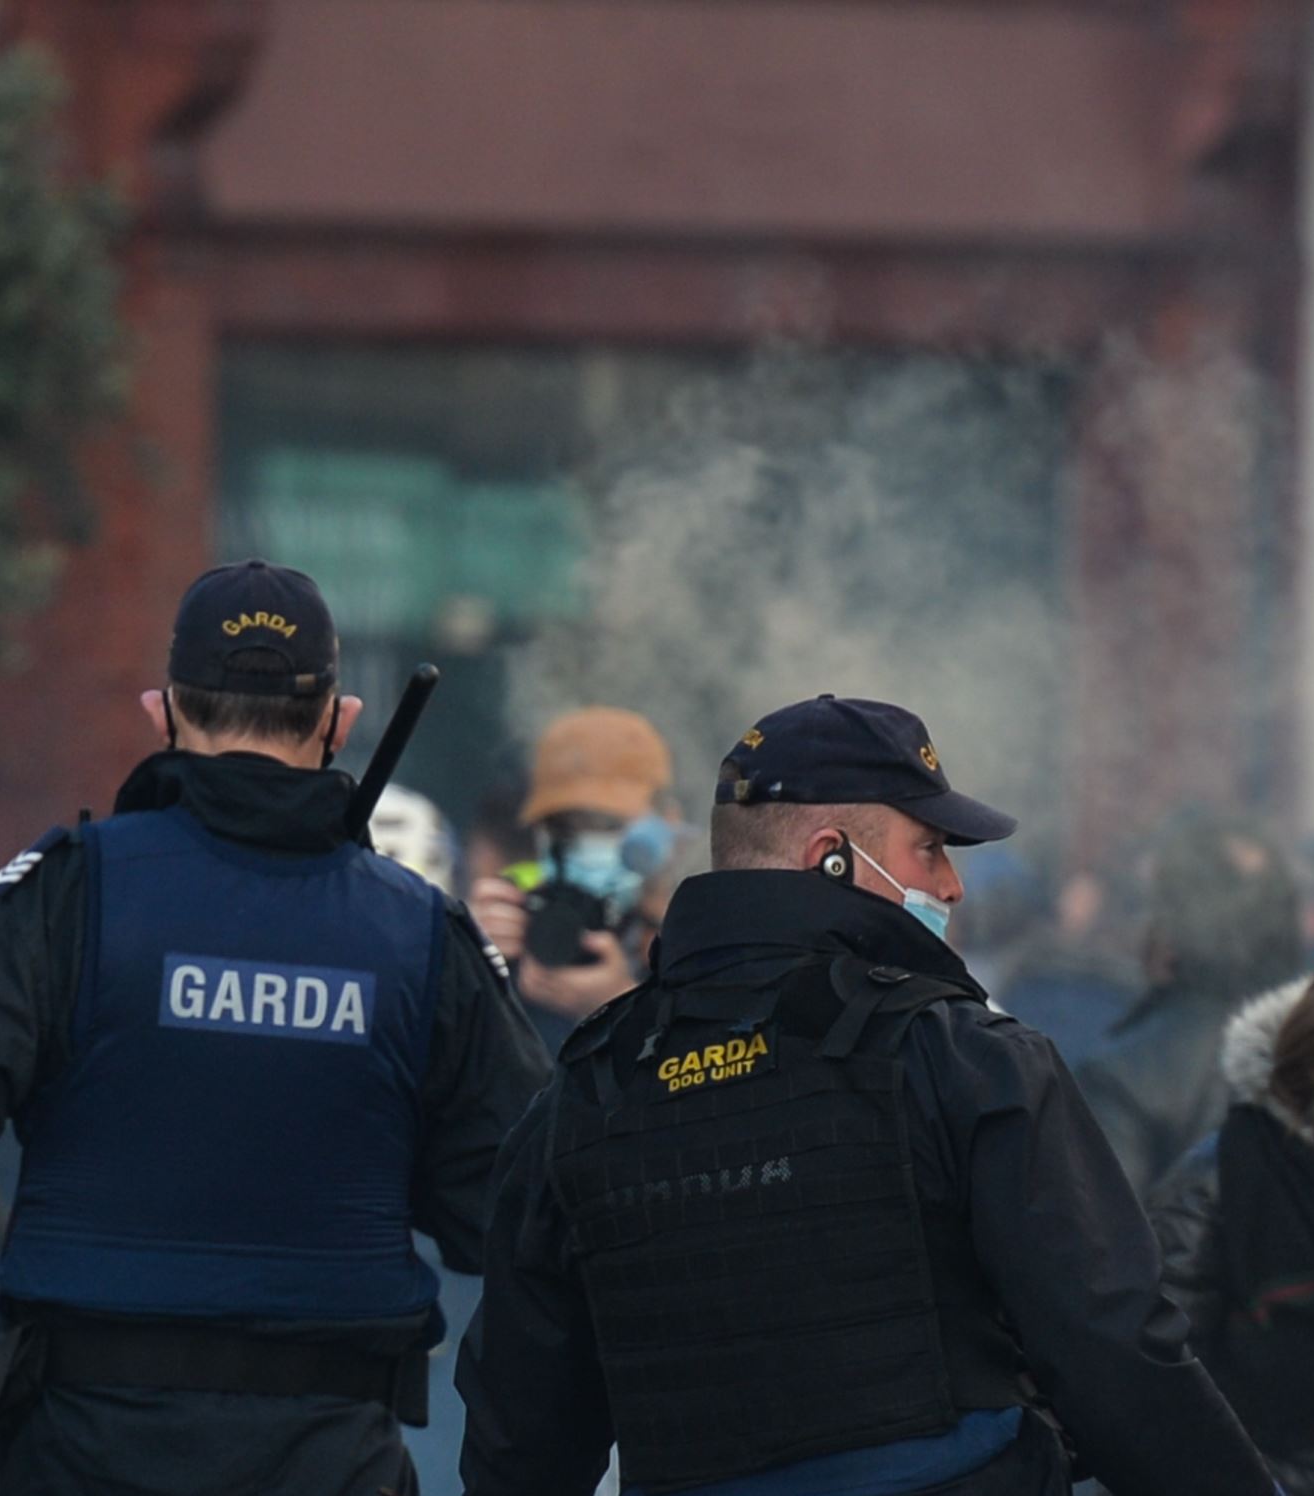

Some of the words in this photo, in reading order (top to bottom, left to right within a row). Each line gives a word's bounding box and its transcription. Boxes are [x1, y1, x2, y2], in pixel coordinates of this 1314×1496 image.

[222, 611, 298, 638] GARDA
[169, 964, 366, 1034] GARDA
[657, 1032, 768, 1081] GARDA
[668, 1071, 706, 1093] DOG
[710, 1059, 756, 1081] UNIT
